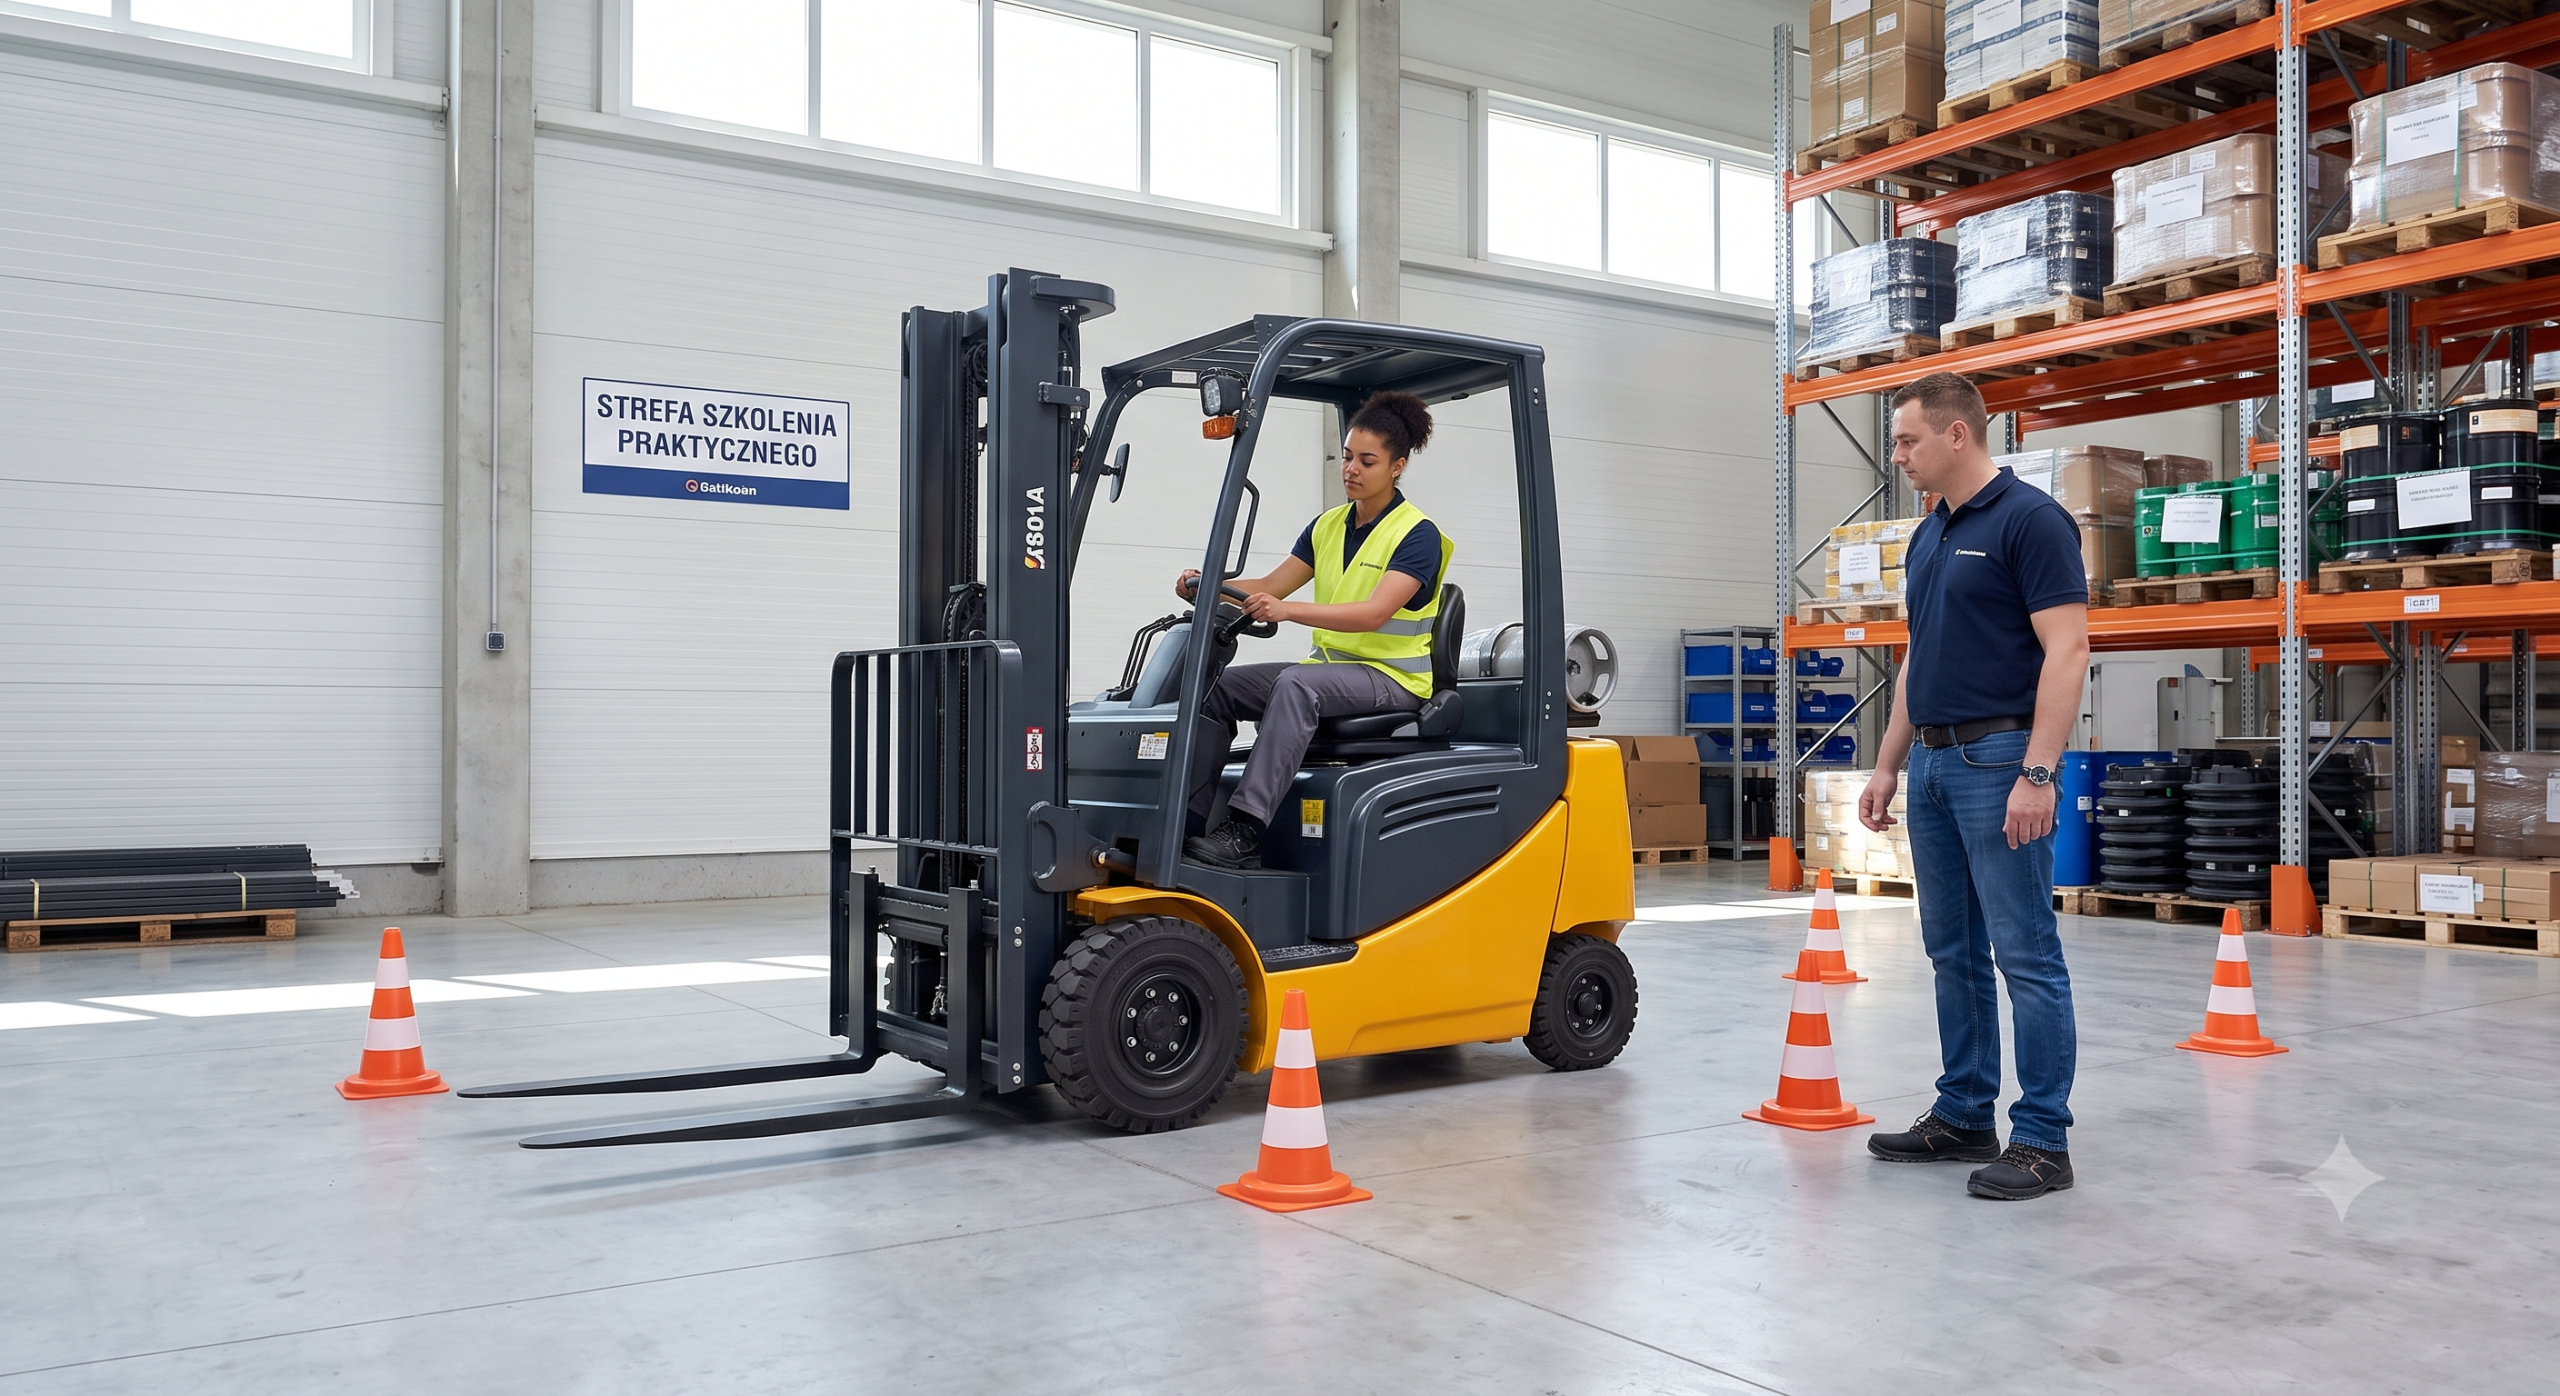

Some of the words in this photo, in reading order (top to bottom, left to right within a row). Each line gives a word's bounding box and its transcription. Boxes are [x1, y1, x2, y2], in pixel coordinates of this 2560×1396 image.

[597, 393, 695, 425] STREFA
[702, 403, 838, 437] SZKOLENIA
[617, 429, 818, 468] PRAKTYCZNEGO
